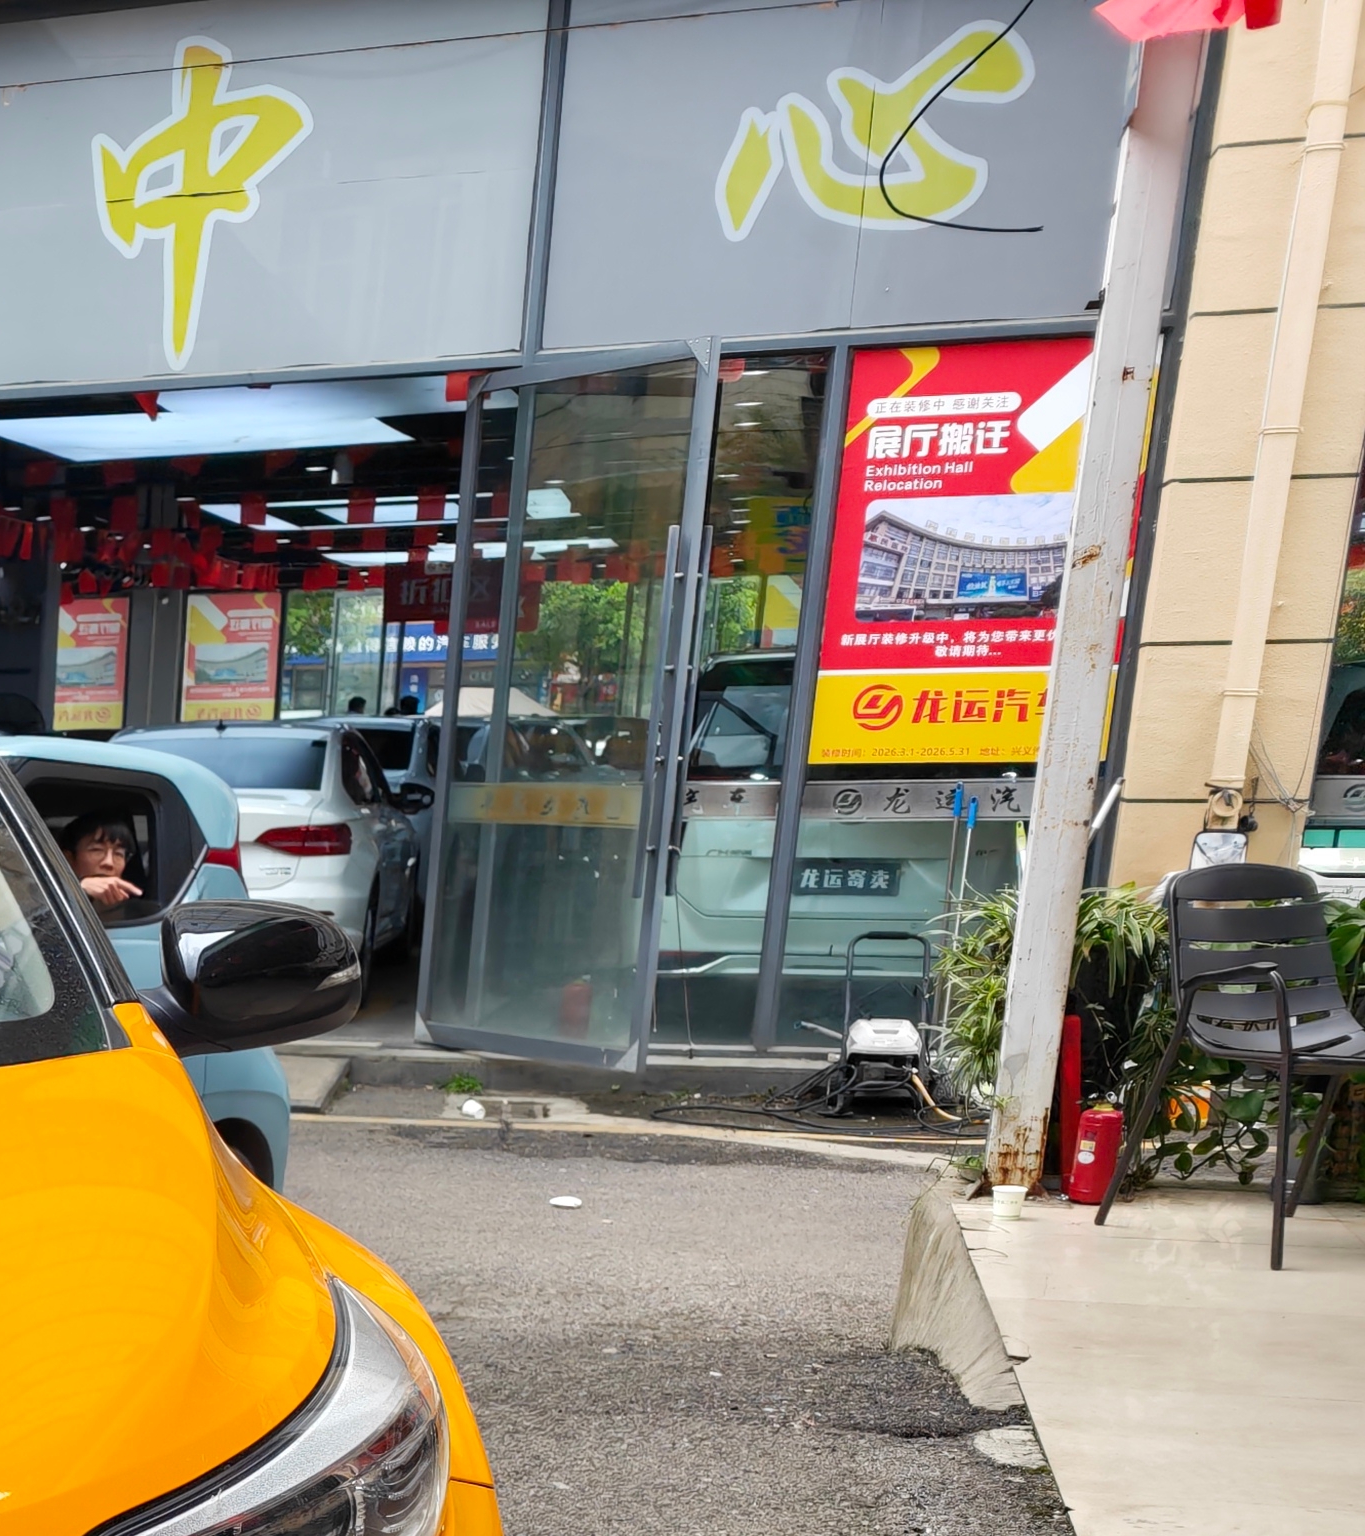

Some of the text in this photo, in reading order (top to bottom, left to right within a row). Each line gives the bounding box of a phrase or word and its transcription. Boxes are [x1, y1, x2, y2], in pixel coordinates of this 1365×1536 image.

[874, 395, 1010, 414] 正在装修中 感谢关注
[866, 419, 1011, 460] 展厅搬迁
[865, 460, 974, 478] Exhibition Hall
[863, 477, 943, 492] Relocation
[799, 868, 890, 890] 龙运寄卖
